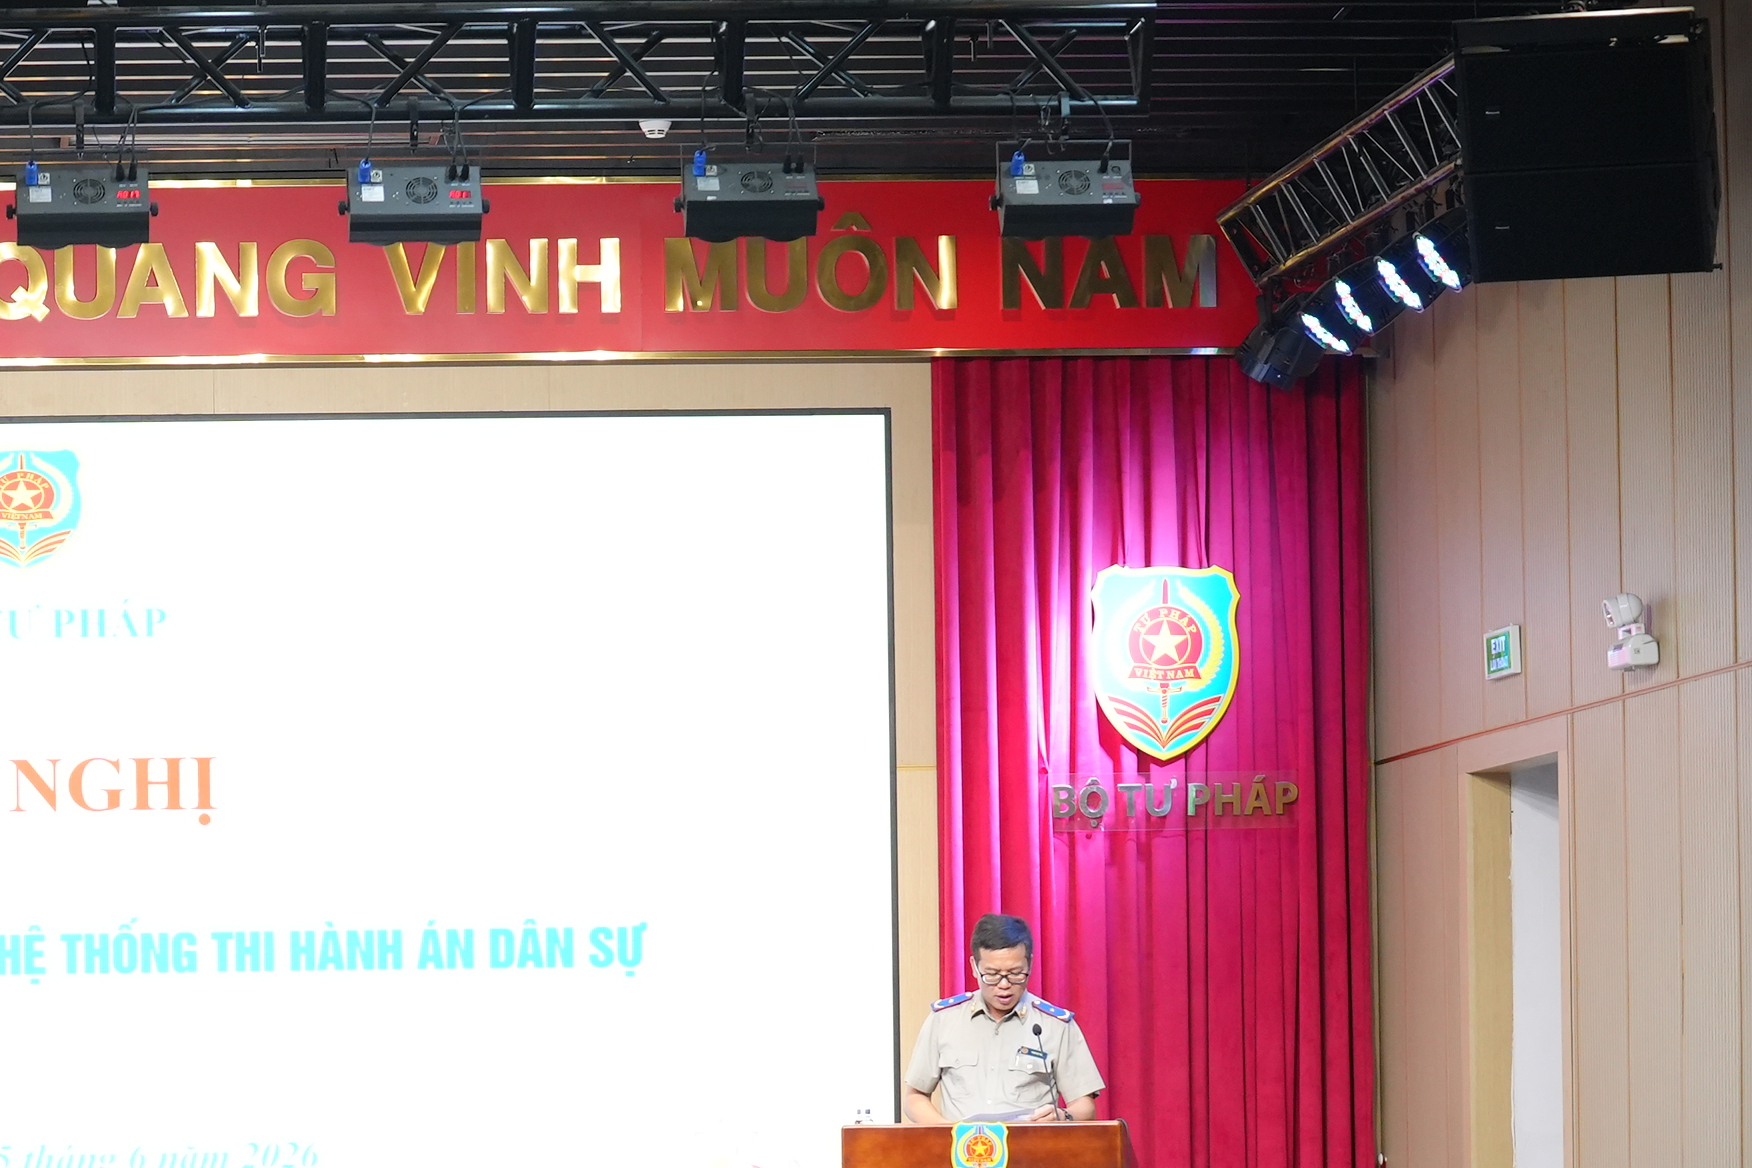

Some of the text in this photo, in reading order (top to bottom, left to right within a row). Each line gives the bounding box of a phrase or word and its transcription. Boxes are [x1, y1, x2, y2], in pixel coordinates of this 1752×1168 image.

[383, 237, 621, 316] VINH
[664, 211, 958, 313] MUÔN
[1000, 234, 1219, 310] NAM
[54, 598, 167, 639] PHÁP
[1159, 608, 1197, 633] PHÁP
[1166, 668, 1195, 679] NAM
[9, 757, 218, 826] NGHỊ
[1052, 774, 1299, 828] BỘ TƯ PHÁP
[61, 917, 197, 974] THỐNG
[212, 931, 274, 972] THI
[290, 921, 402, 971] HÀNH
[418, 920, 474, 969] ÁN
[490, 919, 574, 968] DÂN
[589, 921, 648, 977] SỰ
